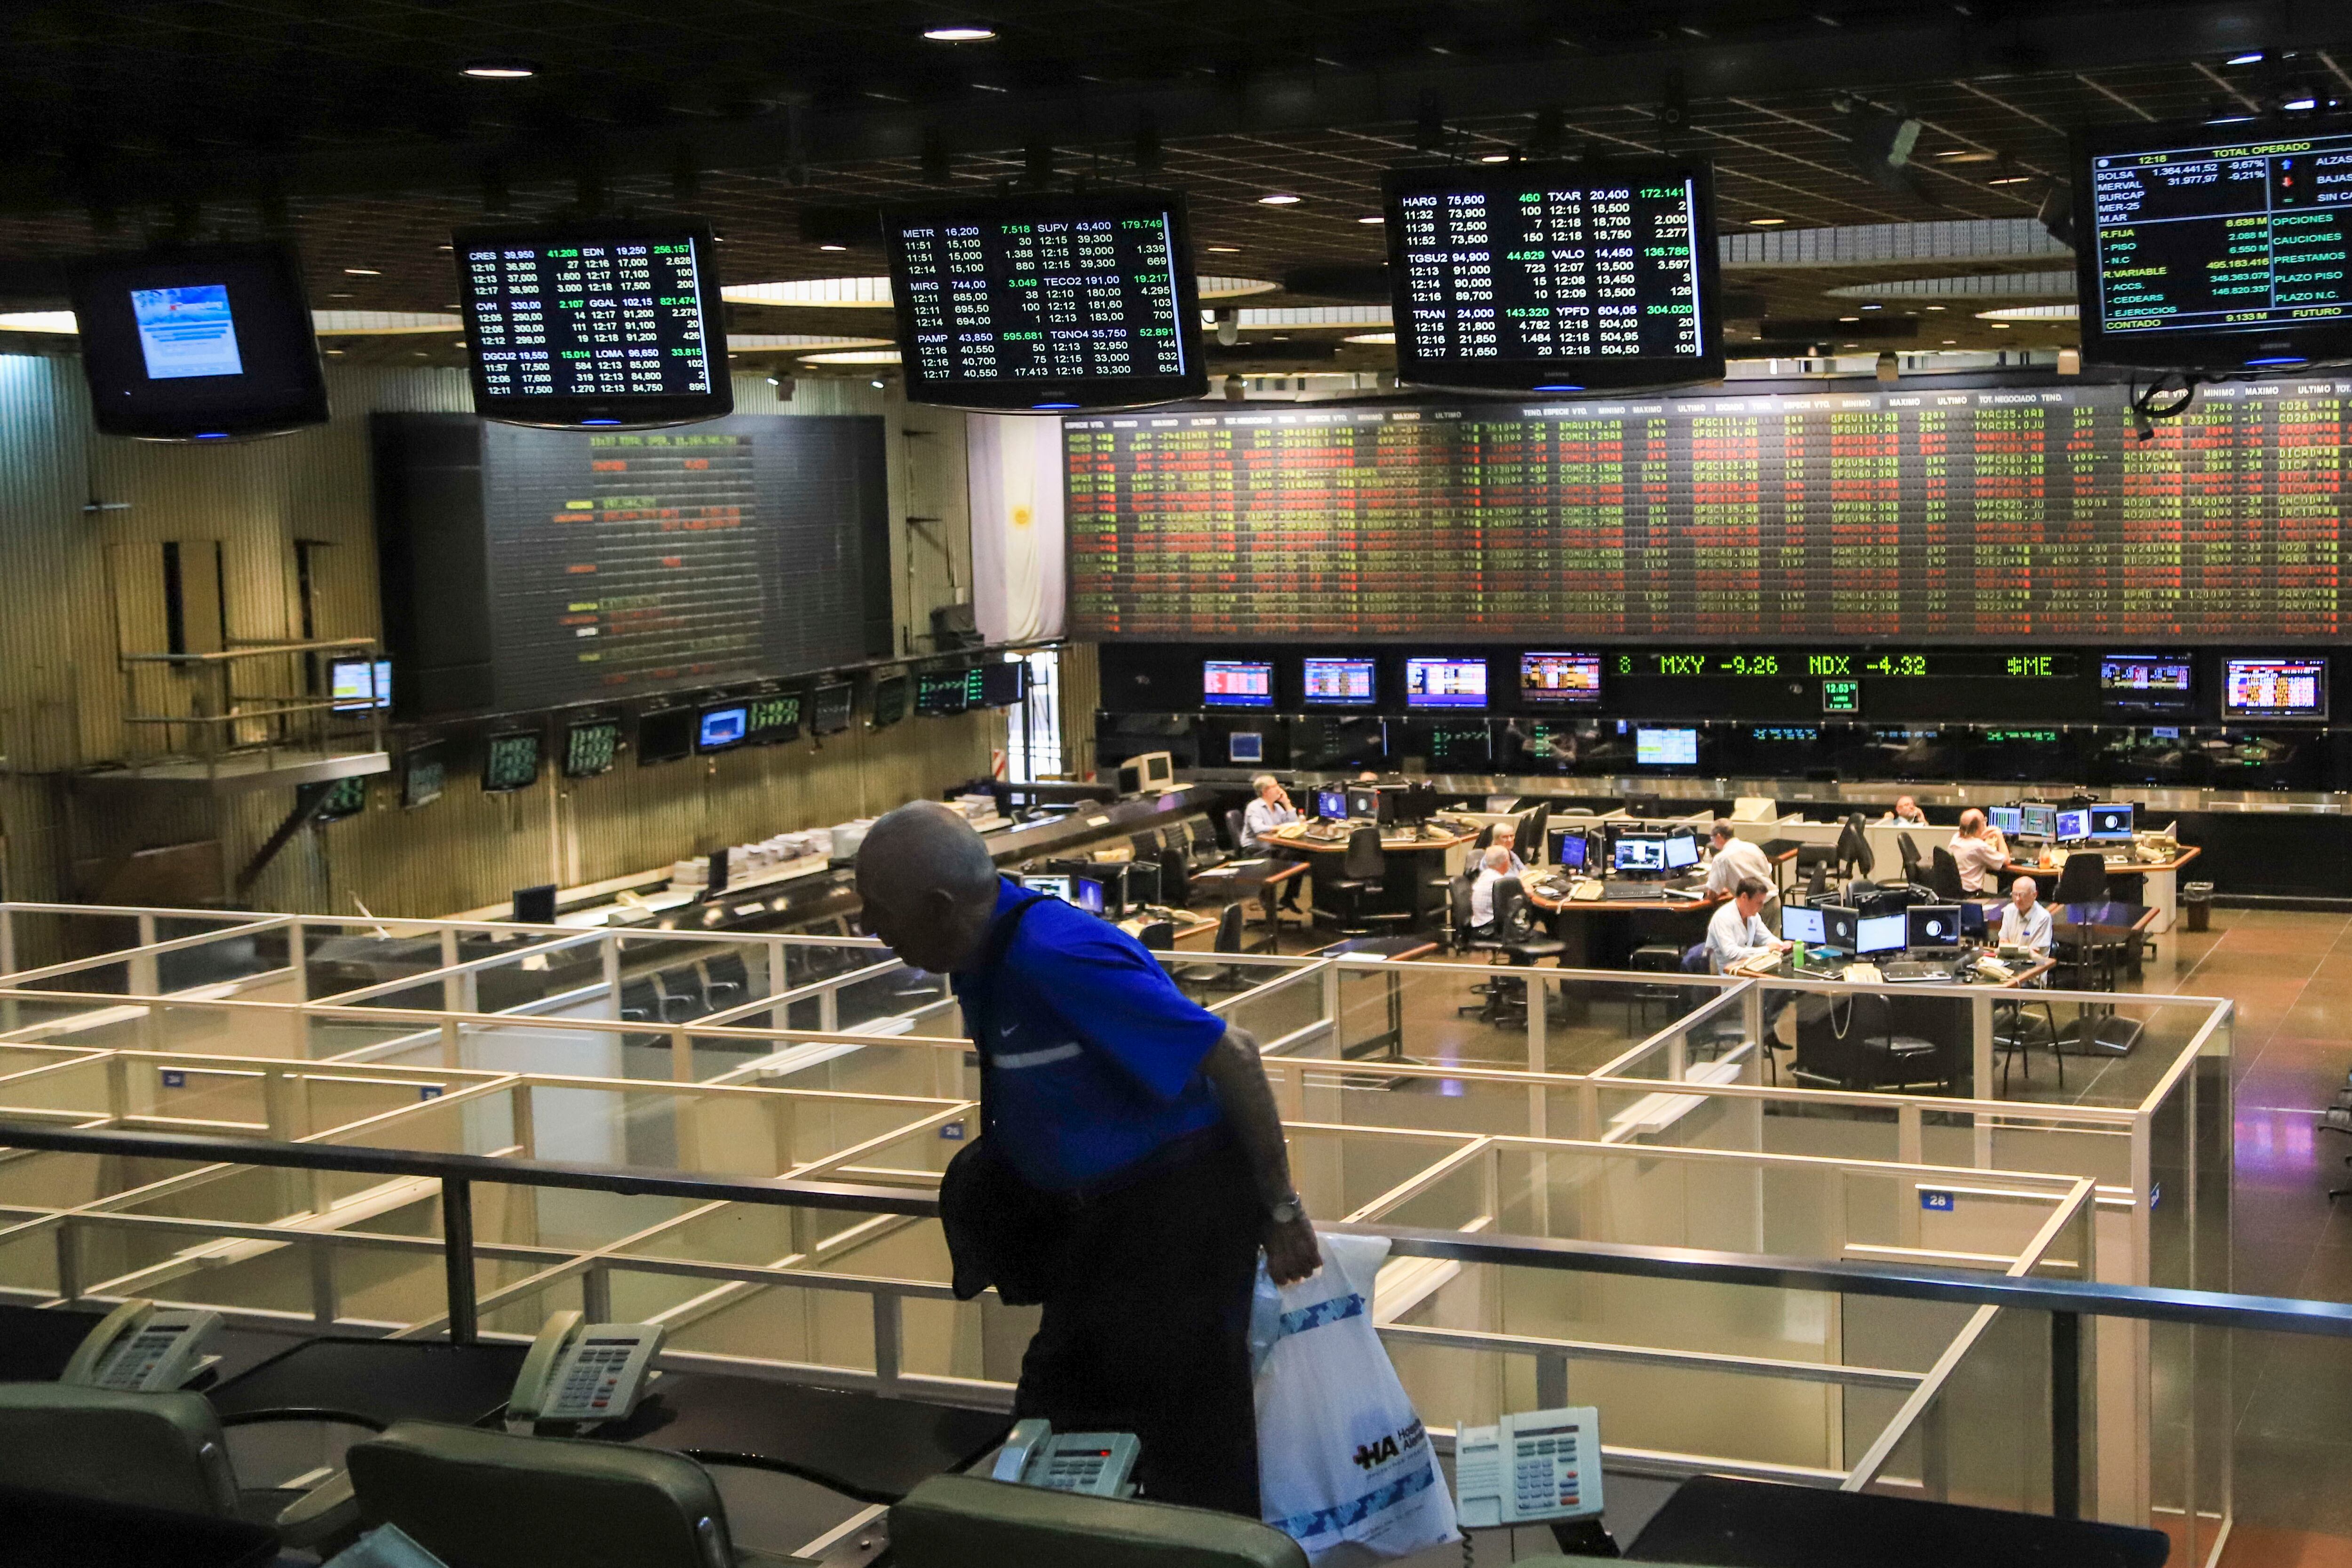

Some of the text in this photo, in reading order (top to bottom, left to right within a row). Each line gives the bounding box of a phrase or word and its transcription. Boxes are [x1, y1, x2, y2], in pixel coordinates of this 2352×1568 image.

[2213, 143, 2310, 158] TOTAL OPERADO
[2139, 155, 2167, 164] 12:18
[2315, 156, 2352, 166] ALZAS
[2098, 171, 2134, 181] BOLSA
[2317, 174, 2352, 184] BAJAS
[2098, 181, 2143, 191] MERVAL
[1403, 193, 1541, 207] HARG 75,600 460
[1547, 188, 1684, 201] TXAR 20,400 172.141
[2098, 191, 2145, 202] BURCAP
[2317, 193, 2337, 201] SIN
[1405, 206, 1542, 220] 11:32 73,900 100
[1549, 201, 1686, 215] 12:15 18,500 2
[2099, 202, 2140, 213] MER-25
[1550, 214, 1687, 228] 12:18 18,700 2.000
[2100, 214, 2127, 223] M.AR
[2272, 215, 2333, 225] OPCIONES
[903, 225, 1030, 238] METR 16,200 7.518
[1037, 220, 1162, 232] SUPV 43,400 179.749
[1406, 219, 1542, 233] 11:39 72,500 7
[2101, 229, 2135, 239] R.FIJA
[2257, 217, 2268, 225] M
[1040, 236, 1067, 245] 12:15
[1077, 234, 1112, 244] 39,300
[1407, 232, 1543, 246] 11:52 73,500 150
[1551, 228, 1688, 241] 12:18 18,750 2.277
[2273, 233, 2342, 245] CAUCIONES
[906, 237, 1032, 250] 11:51 15,100 30
[2111, 243, 2137, 251] PISO
[582, 245, 689, 256] EDN 19,250 256.157
[907, 249, 1033, 262] 11:51 15,000 1.388
[1041, 245, 1165, 257] 12:15 39,000 1.339
[469, 252, 497, 261] CRES
[584, 256, 691, 268] 12:16 17,000 2.628
[2274, 252, 2345, 263] PRESTAMOS
[471, 263, 496, 272] 12:10
[567, 260, 579, 269] 27
[908, 262, 1035, 274] 12:14 15,100 880
[1042, 257, 1167, 270] 12:15 39,300 669
[473, 272, 581, 284] 12:13 37,000 1.600
[586, 268, 692, 280] 12:17 17,100 100
[2103, 267, 2167, 278] R.VARIABLE
[2275, 271, 2343, 283] PLAZO PISO
[474, 286, 499, 295] 12:17
[557, 284, 582, 293] 3.000
[588, 280, 694, 291] 12:18 17,500 200
[2114, 294, 2164, 304] CEDEARS
[2276, 293, 2312, 302] PLAZO
[2115, 306, 2177, 317] EJERCICIOS
[2292, 308, 2341, 317] FUTURO
[2106, 319, 2161, 329] CONTADO
[2225, 313, 2255, 322] 9.133
[2204, 388, 2234, 397] MINIMO
[2245, 387, 2279, 396] MAXIMO
[2298, 385, 2331, 394] ULTIMO
[1889, 398, 1921, 406] MAXIMO
[1938, 396, 1967, 406] ULTIMO
[1994, 395, 2037, 403] NEGOCIADO
[1633, 406, 1662, 414] MAXIMO
[1620, 656, 1631, 674] 8
[1661, 655, 1705, 674] MXY
[1810, 655, 1850, 675] NDX
[2007, 656, 2052, 676] $ME
[1930, 1195, 1946, 1206] 28
